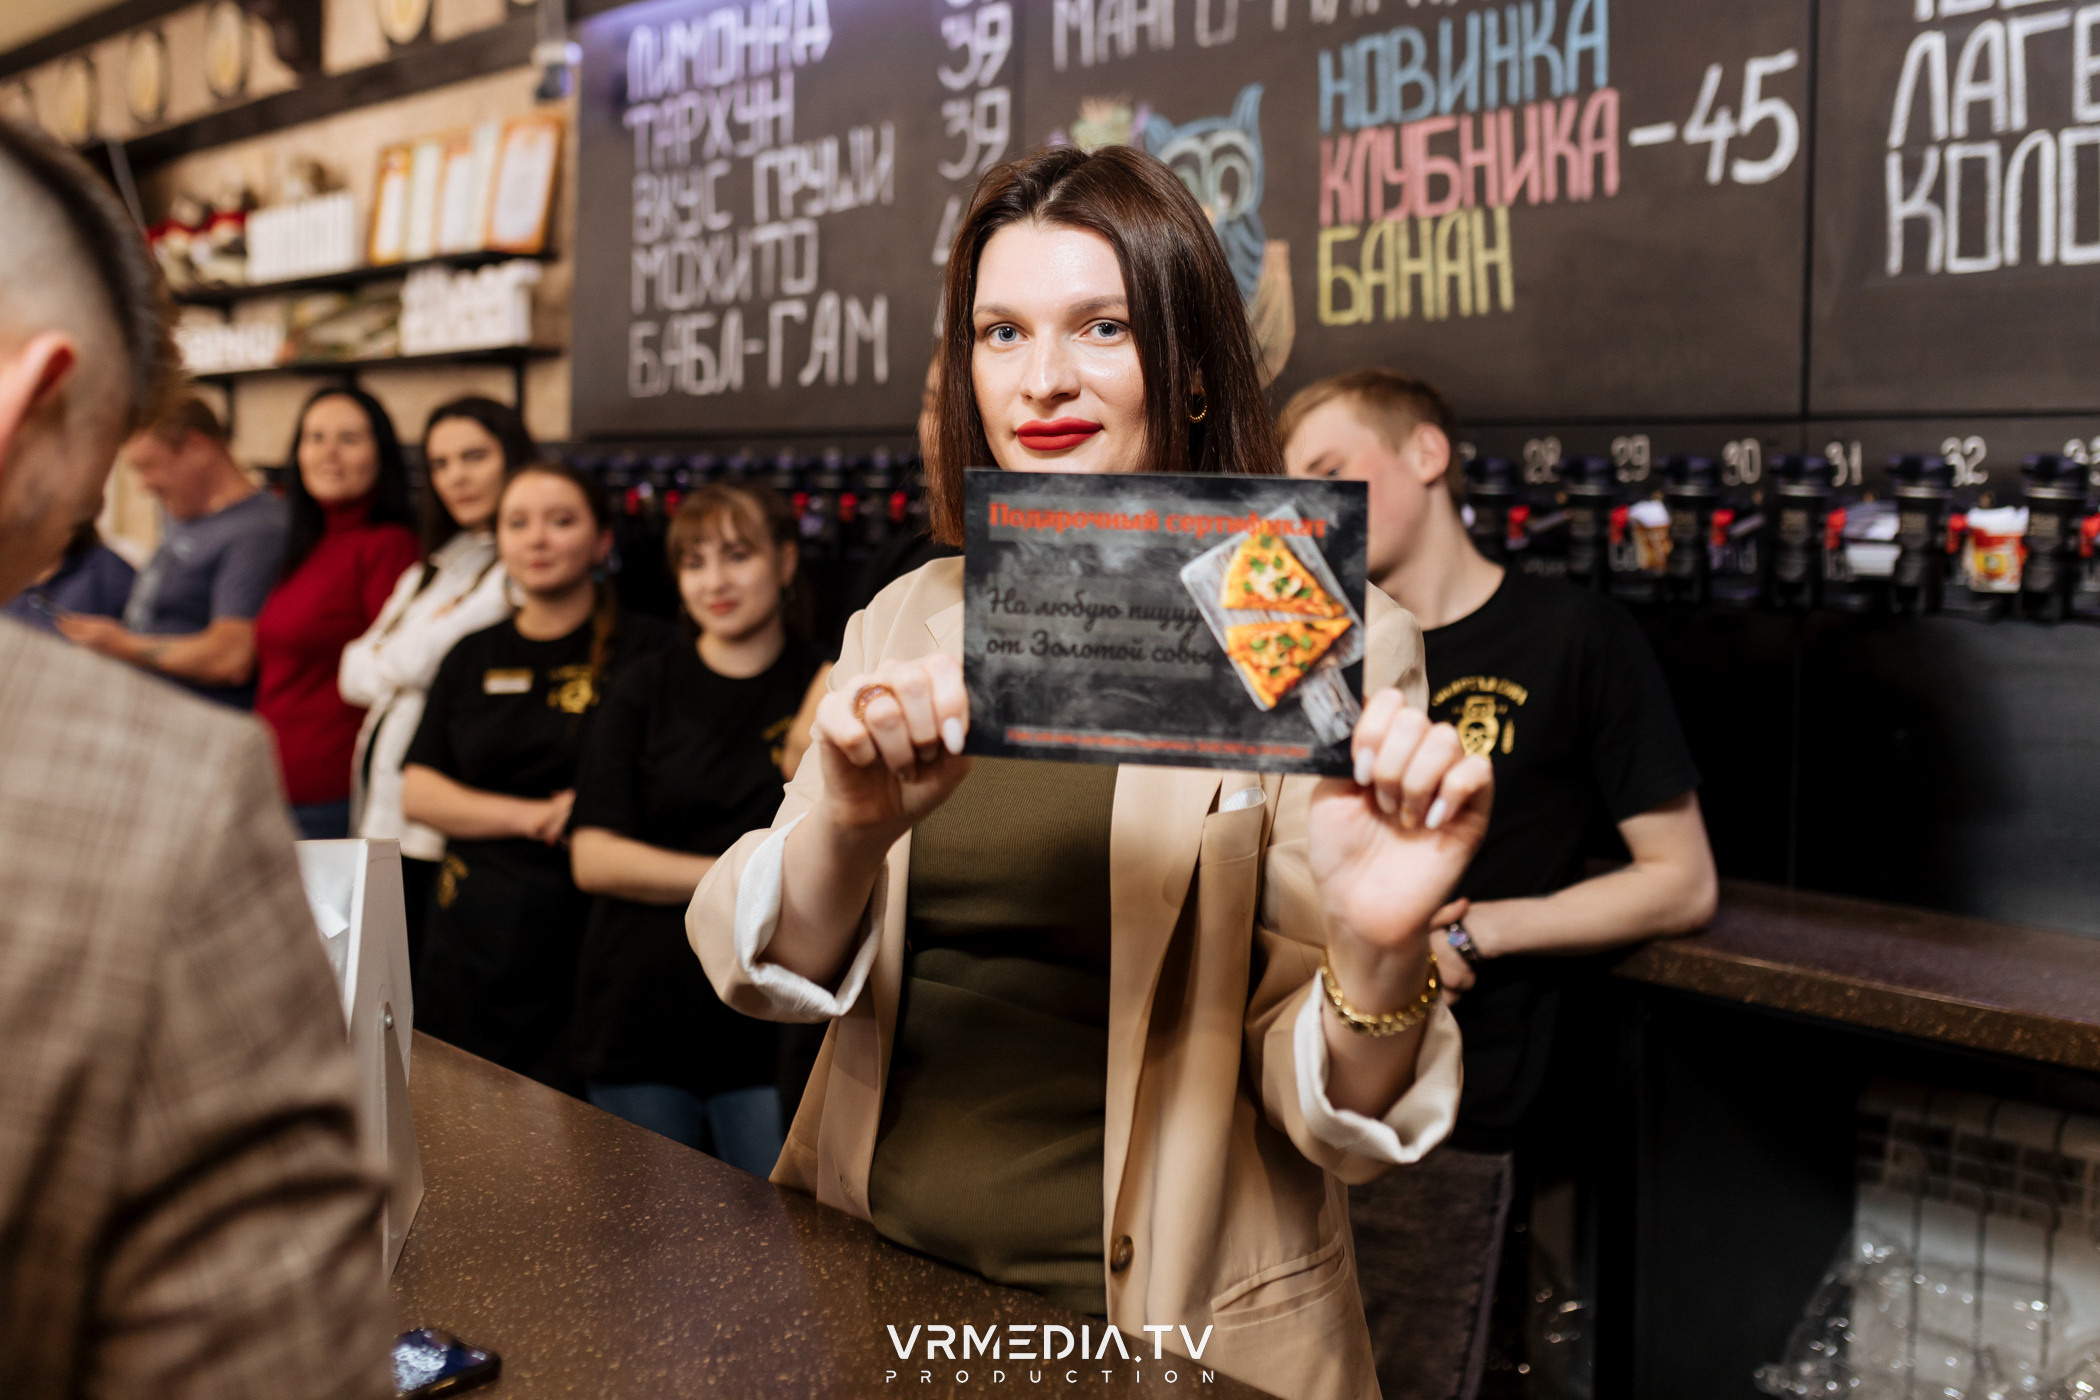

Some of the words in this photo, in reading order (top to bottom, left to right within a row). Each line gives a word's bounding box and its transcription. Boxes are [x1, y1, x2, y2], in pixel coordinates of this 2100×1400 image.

[937, 2, 1013, 91] 39
[1318, 0, 1609, 134] НОВИНКА
[622, 68, 795, 173] ТАРХУН
[937, 85, 1011, 181] 39
[1320, 87, 1620, 227] КЛУБНИКА
[631, 158, 733, 245] ВКУС
[752, 120, 896, 223] ГРУШИ
[630, 218, 819, 315] МОХИТО
[1317, 205, 1515, 326] БАНАН
[627, 290, 889, 398] БАБЛ-ГАМ
[1825, 440, 1863, 487] 31
[1941, 435, 1989, 487] 32
[989, 501, 1160, 534] Подарочный
[987, 587, 1029, 615] На
[1034, 589, 1124, 632] любую
[987, 638, 1025, 655] от
[1030, 629, 1147, 662] Золотой
